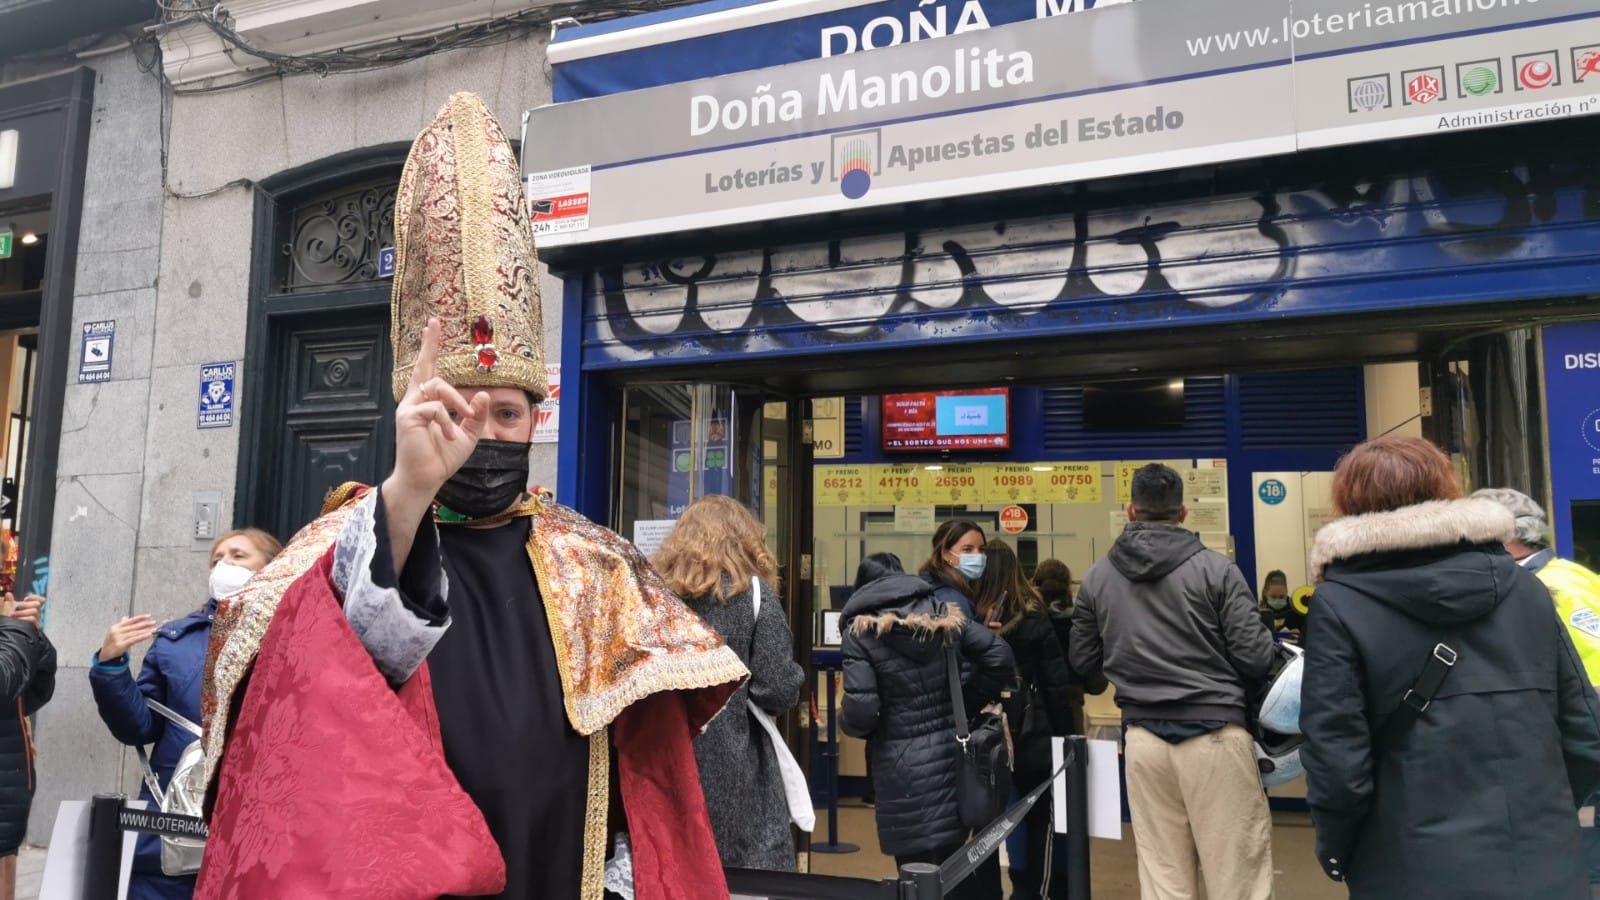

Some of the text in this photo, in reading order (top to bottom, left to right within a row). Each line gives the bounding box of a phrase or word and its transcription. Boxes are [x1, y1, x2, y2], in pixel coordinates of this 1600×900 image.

[690, 46, 1034, 137] Doña Manolita
[1437, 101, 1572, 130] Administración
[705, 106, 1184, 193] Loterías y Apuestas del Estado
[534, 223, 551, 233] 24h
[824, 478, 863, 488] 66212
[879, 477, 919, 487] 41710
[935, 476, 975, 486] 26590
[993, 475, 1033, 486] 10989
[1051, 474, 1092, 485] 00750
